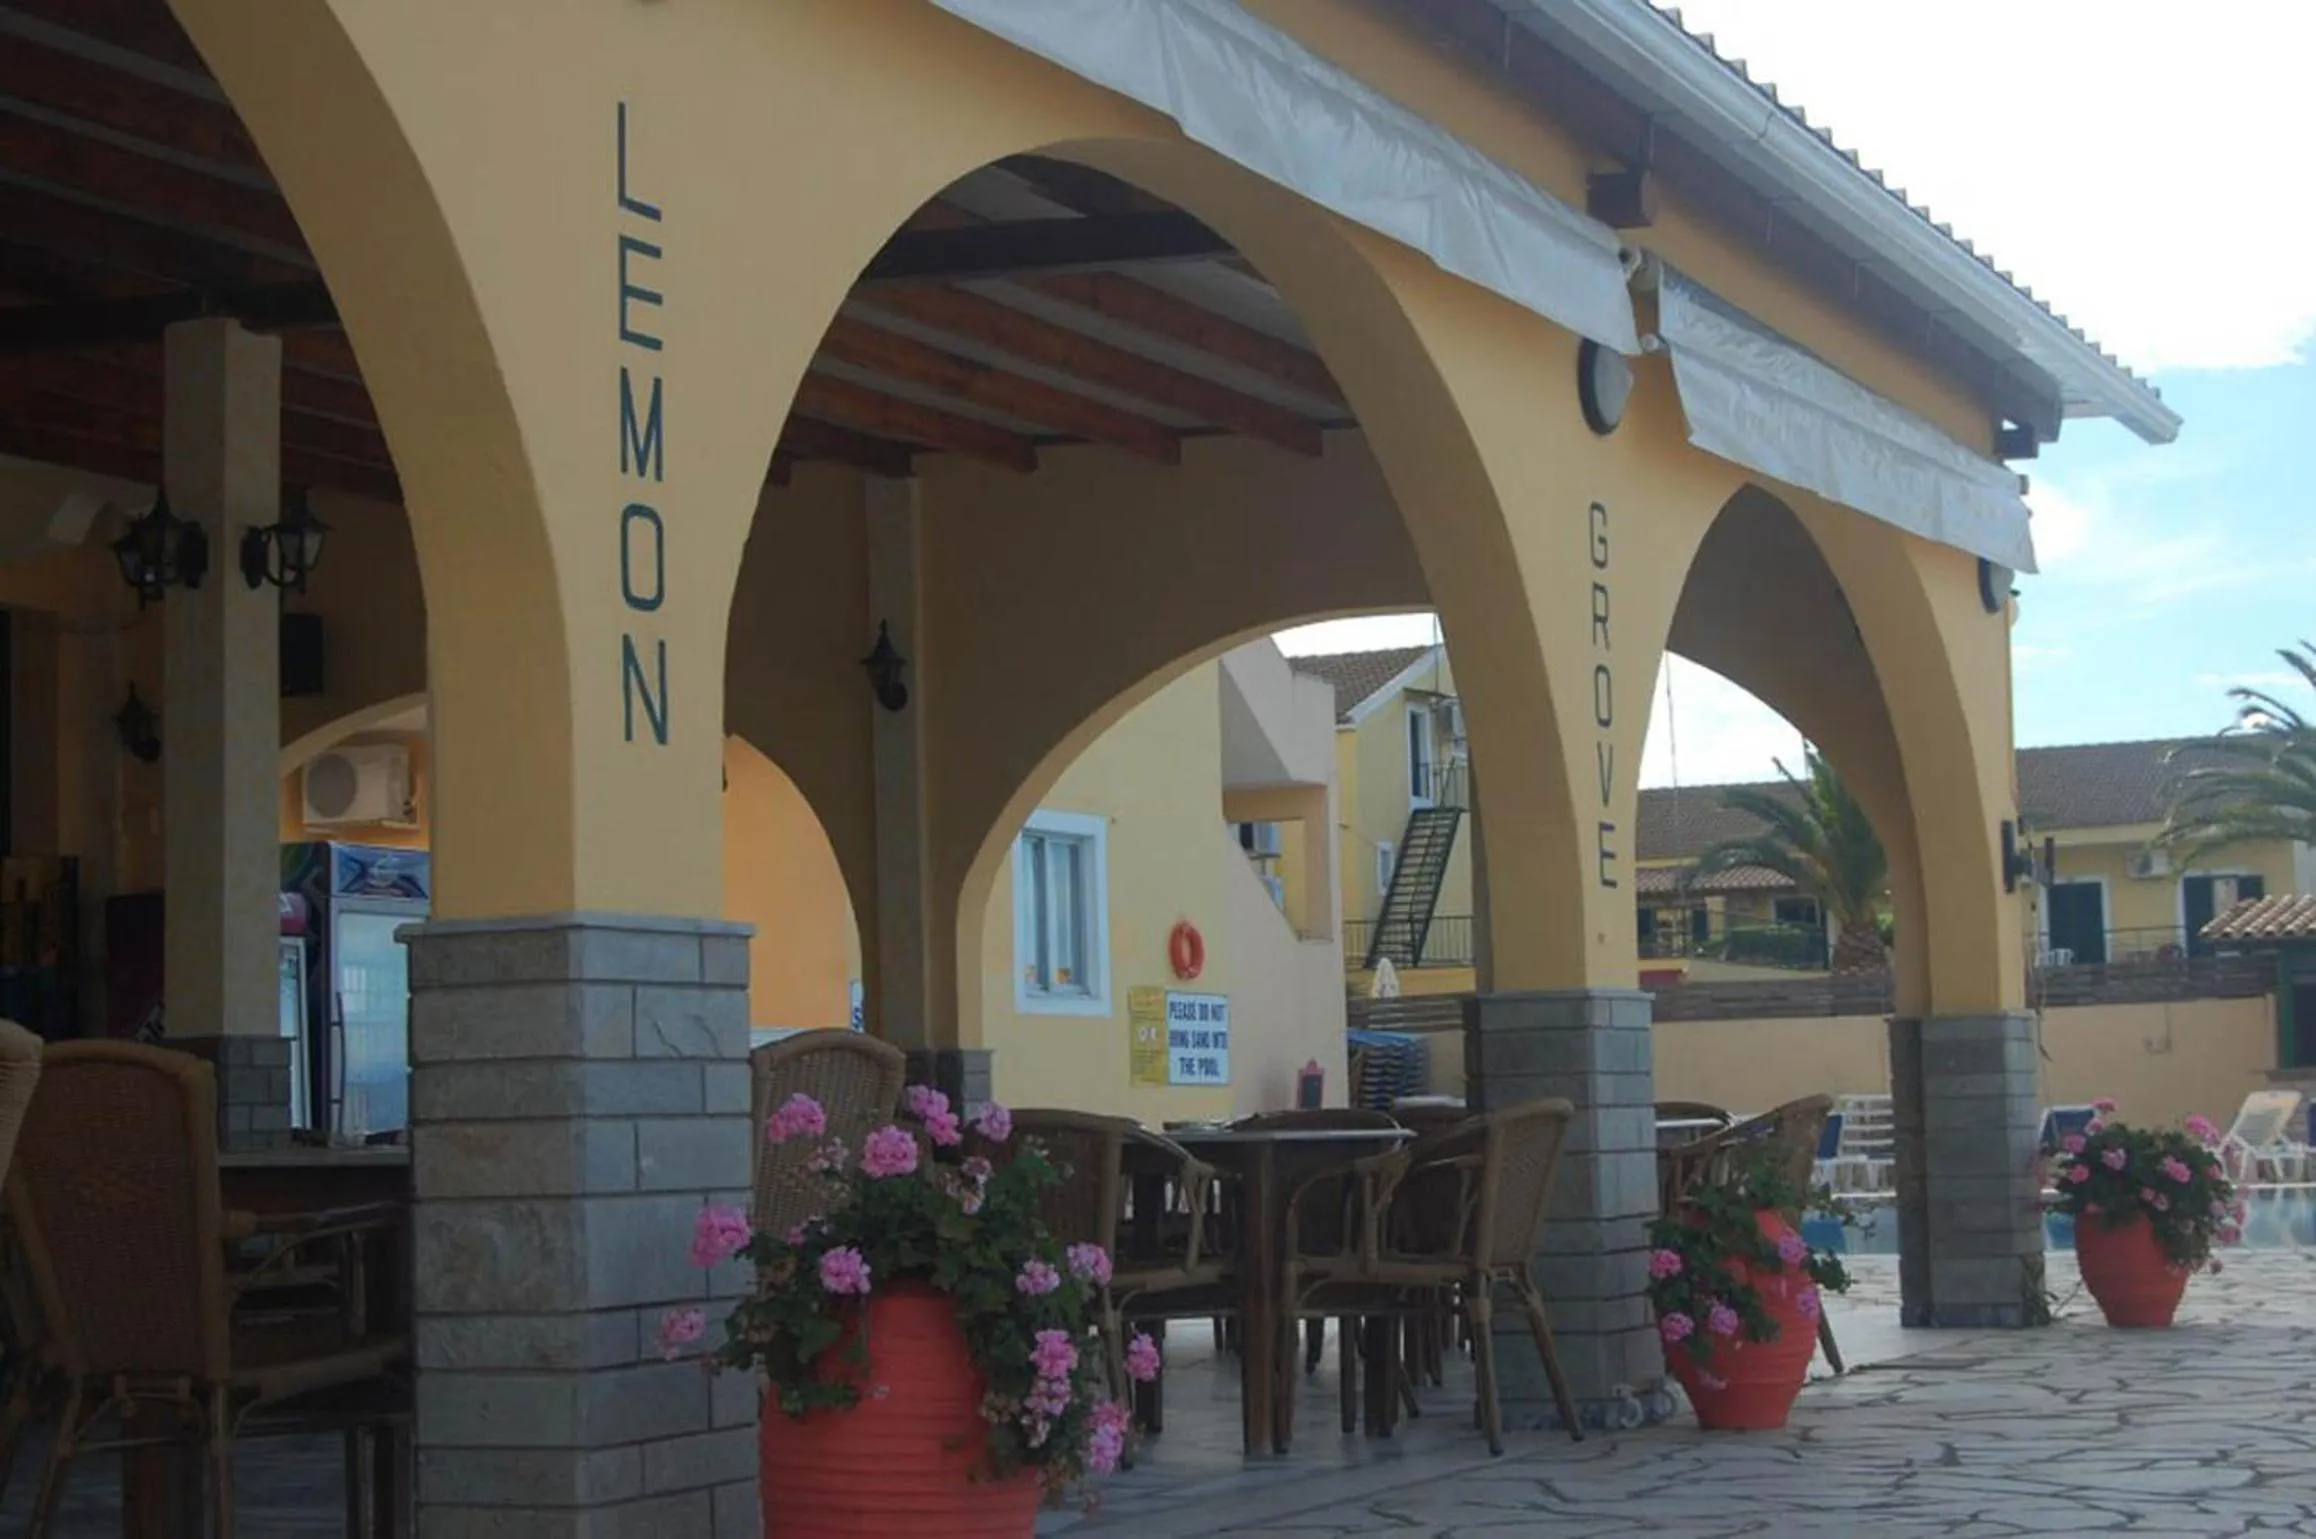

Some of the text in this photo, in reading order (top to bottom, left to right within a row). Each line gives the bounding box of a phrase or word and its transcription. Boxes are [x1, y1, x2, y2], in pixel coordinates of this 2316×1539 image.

[618, 101, 668, 746] LEMON
[1589, 501, 1618, 889] GROVE
[1169, 1000, 1197, 1021] PLEASE
[1198, 1003, 1209, 1021] DO
[1211, 1003, 1226, 1021] NOT
[1179, 1056, 1196, 1076] THE
[1198, 1057, 1221, 1077] POOL
